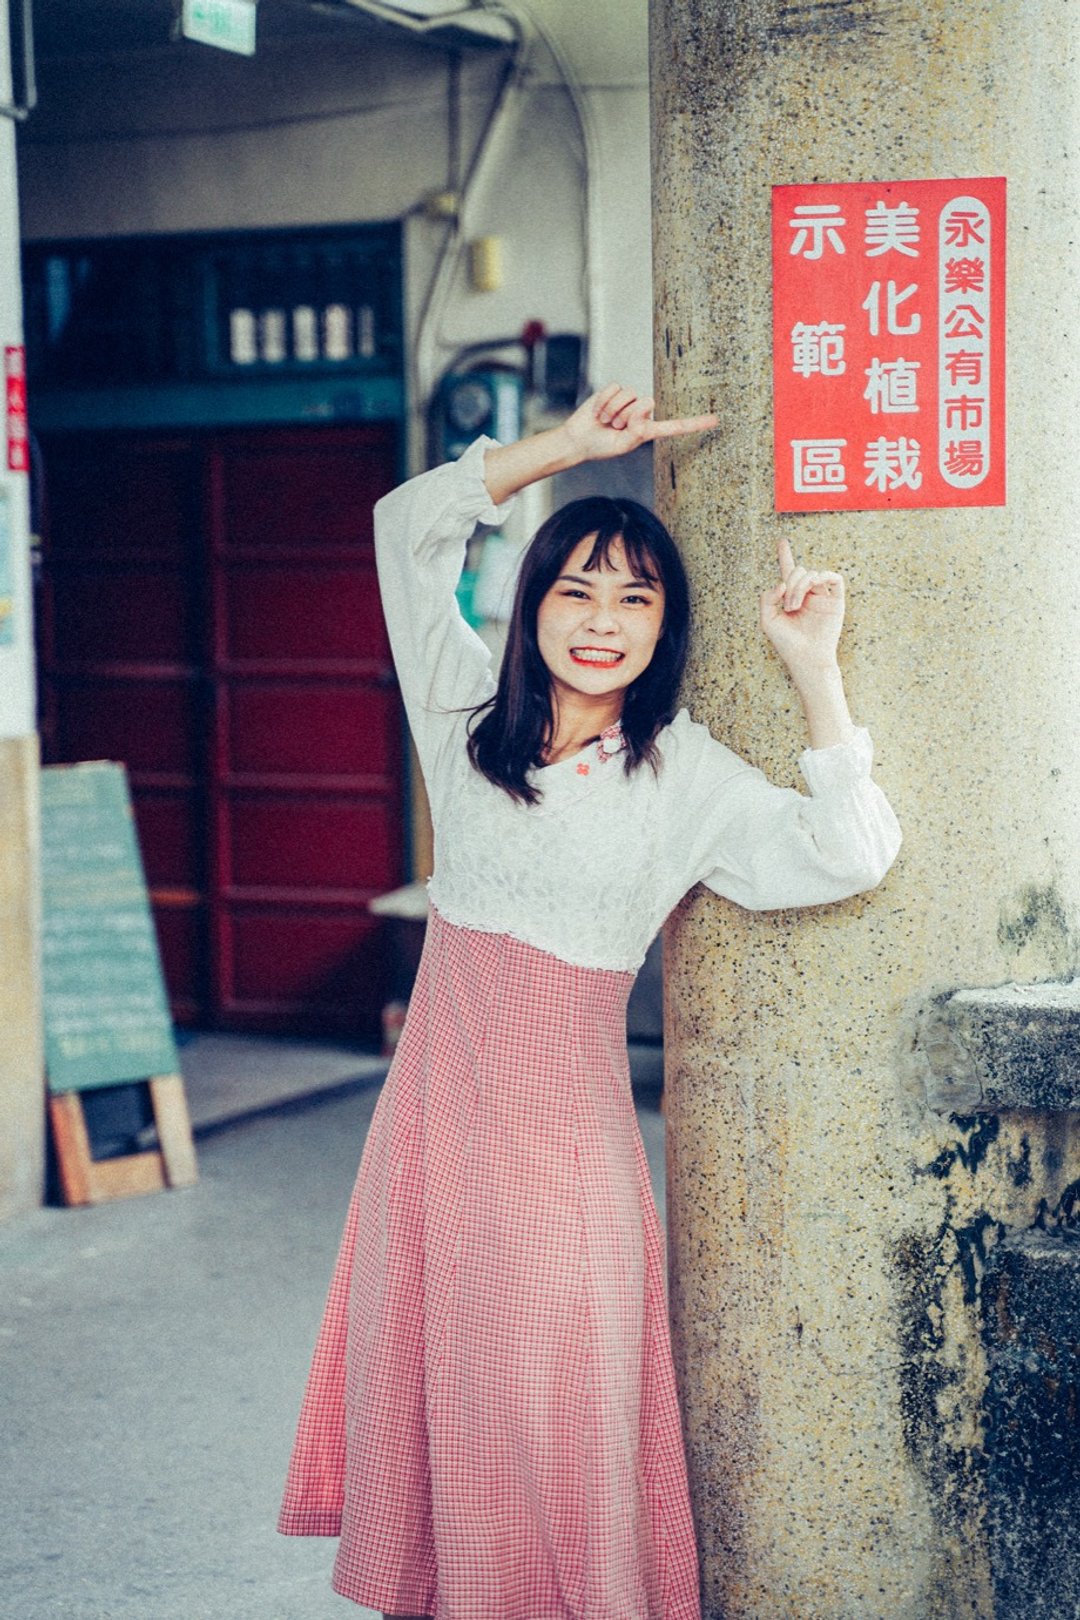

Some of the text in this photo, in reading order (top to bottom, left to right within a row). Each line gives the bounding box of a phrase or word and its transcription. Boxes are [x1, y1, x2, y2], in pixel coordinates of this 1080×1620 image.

[789, 204, 848, 494] 示範區
[861, 201, 922, 493] 美化植栽
[944, 210, 986, 477] 永樂公有市場
